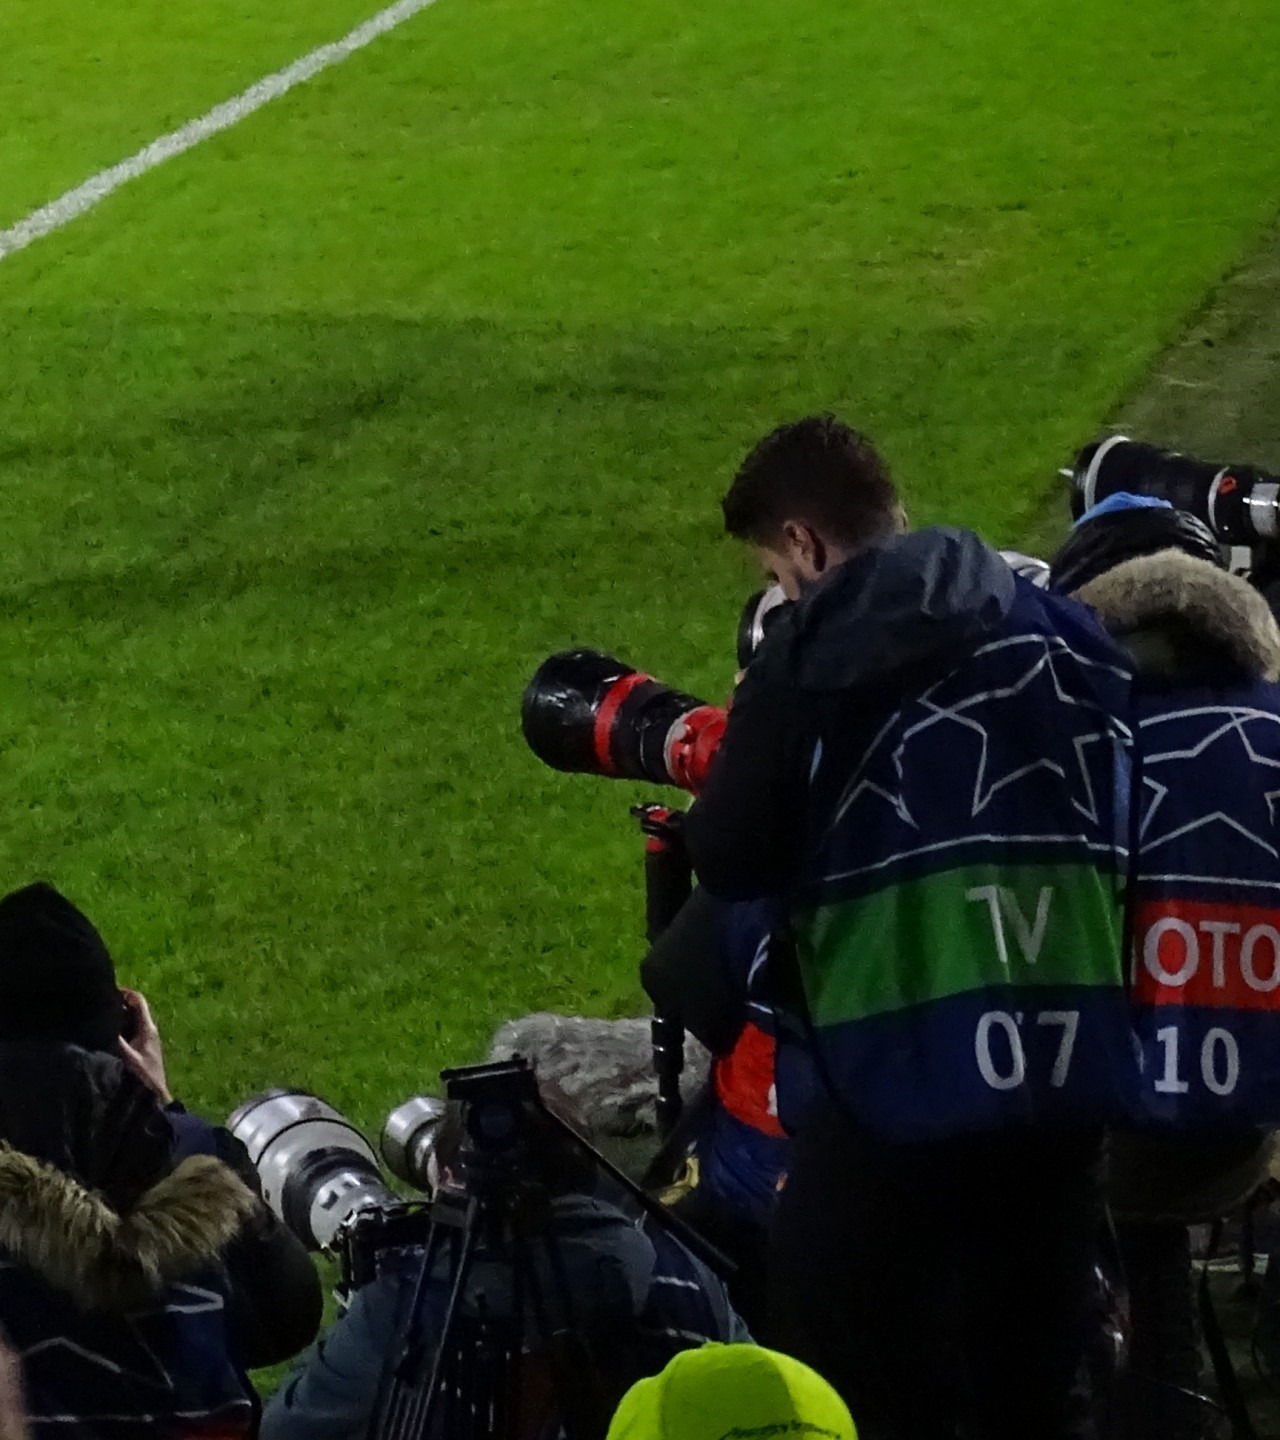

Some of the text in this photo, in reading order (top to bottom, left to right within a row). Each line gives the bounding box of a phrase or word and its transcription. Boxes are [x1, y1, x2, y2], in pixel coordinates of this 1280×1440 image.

[965, 885, 1055, 964] TV
[974, 1010, 1080, 1091] 07
[1153, 1025, 1240, 1096] 10
